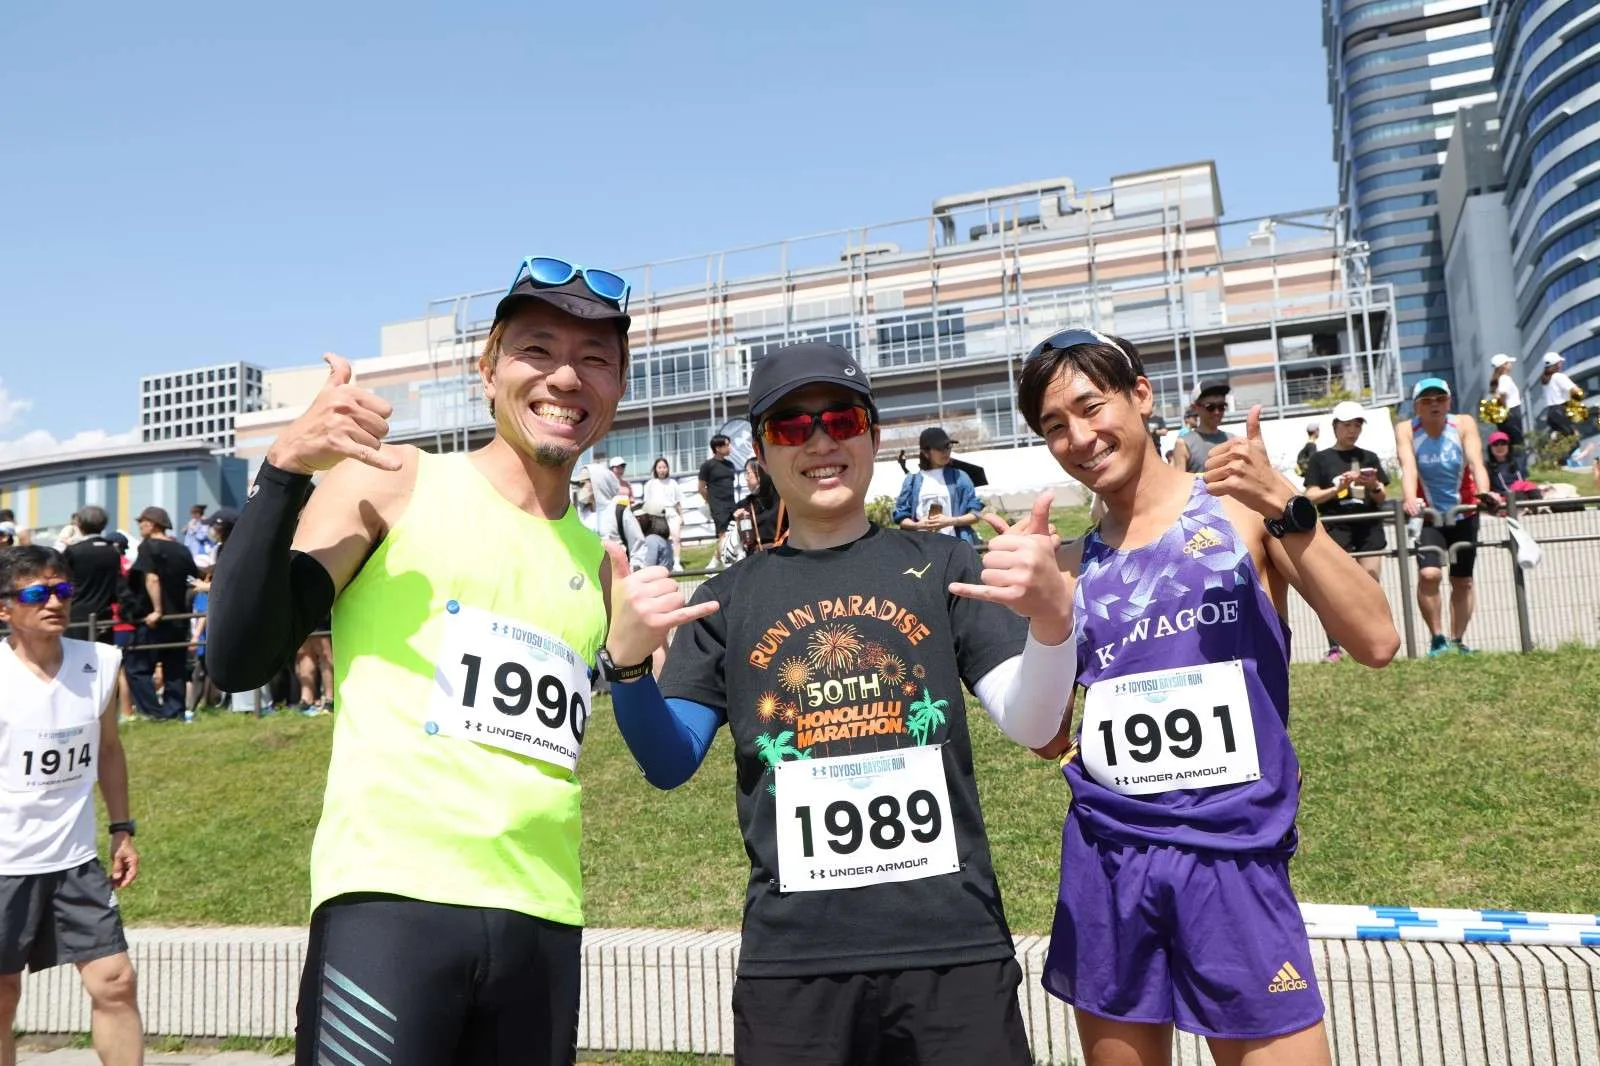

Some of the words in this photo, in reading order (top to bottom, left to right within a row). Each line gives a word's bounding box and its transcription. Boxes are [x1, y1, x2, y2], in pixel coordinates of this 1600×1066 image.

[511, 627, 543, 648] TOYOSU
[750, 620, 791, 669] RUN
[787, 604, 816, 630] IN
[818, 595, 931, 646] PARADISE
[806, 673, 881, 707] 50TH
[1128, 679, 1158, 694] TOYOSU
[1187, 673, 1203, 685] RUN
[460, 653, 587, 745] 1990
[797, 700, 902, 732] HONOLULU
[486, 725, 532, 743] UNDER
[1098, 705, 1236, 766] 1991
[23, 743, 92, 776] 1914
[829, 762, 862, 778] TOYOSU
[863, 759, 892, 775] BAYSIDE
[892, 756, 906, 771] RUN
[1132, 773, 1173, 784] UNDER
[1175, 766, 1228, 780] ARMOUR
[795, 789, 942, 857] 1989
[829, 866, 875, 878] UNDER
[876, 857, 929, 873] ARMOUR
[1268, 979, 1307, 992] adidas
